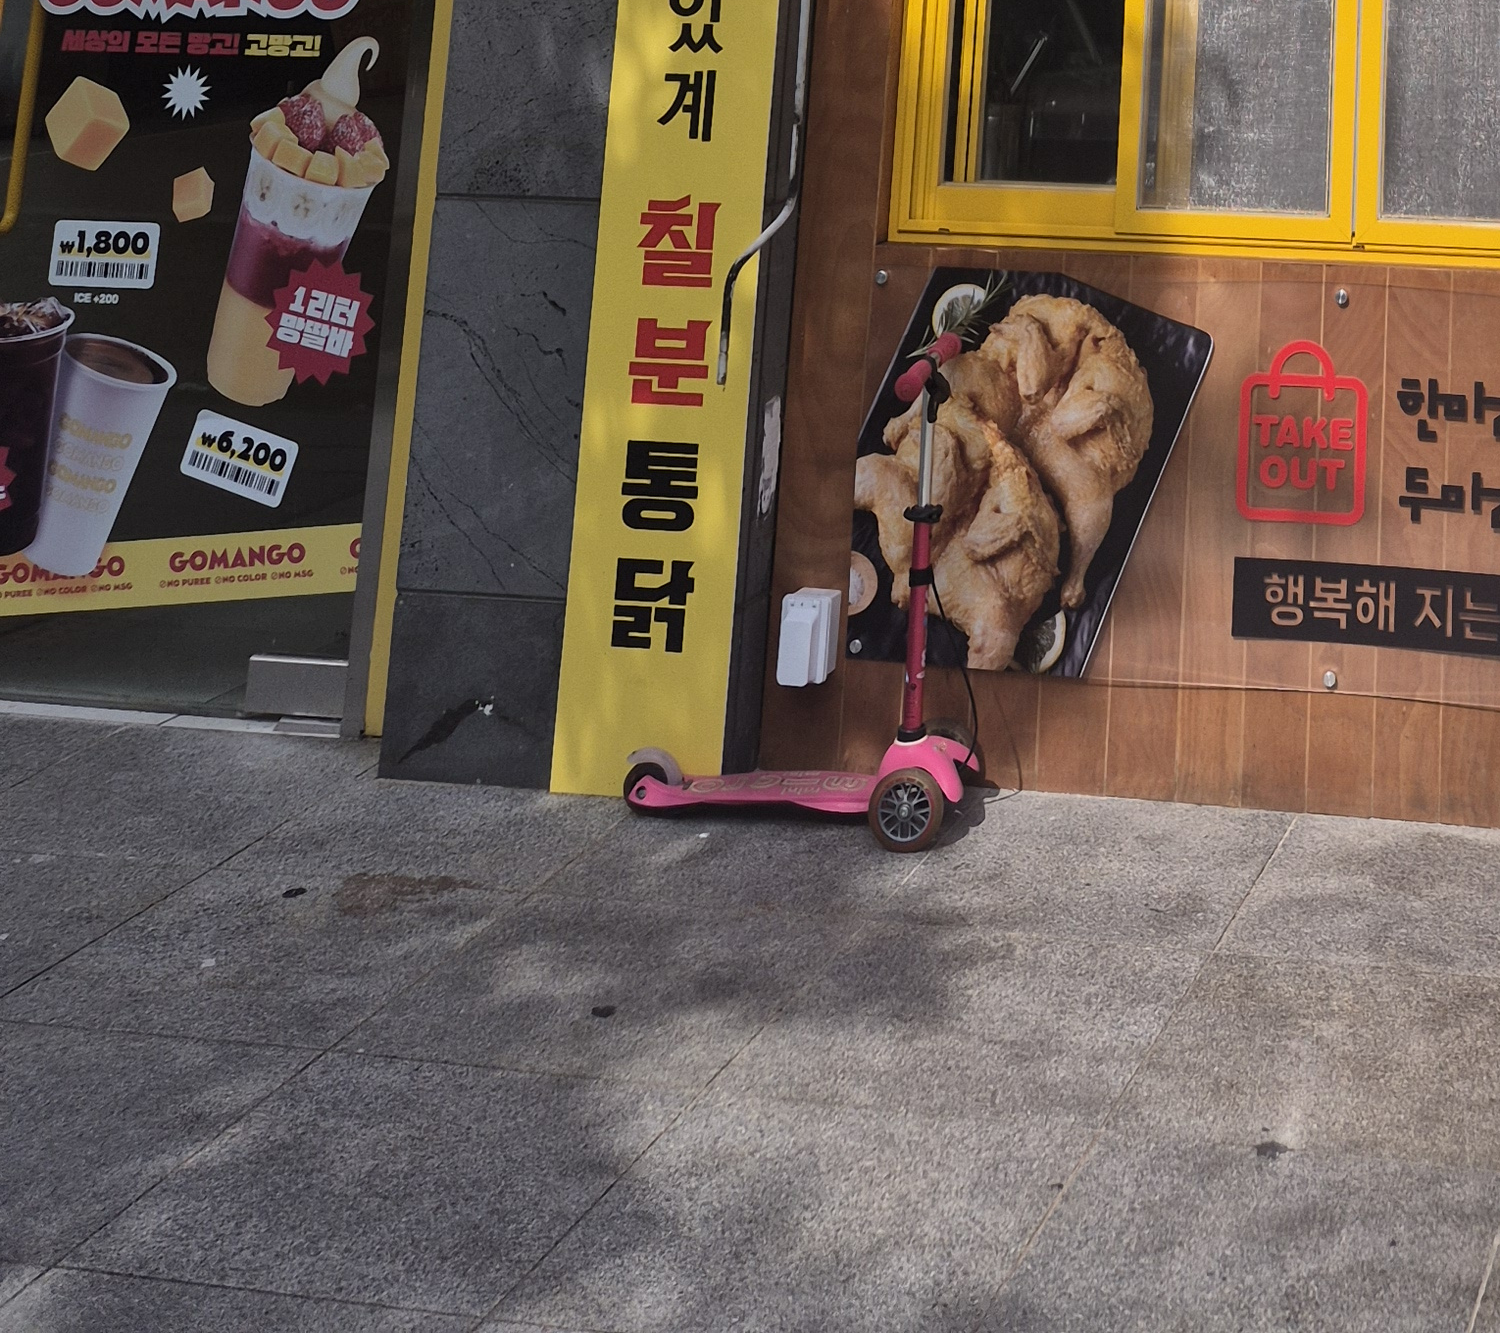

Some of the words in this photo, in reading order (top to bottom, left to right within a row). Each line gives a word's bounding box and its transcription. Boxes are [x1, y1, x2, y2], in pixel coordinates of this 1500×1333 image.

[61, 29, 131, 52] 세상의
[134, 32, 182, 54] 모든
[244, 34, 322, 57] 고망고!
[74, 292, 92, 303] ICE
[628, 194, 721, 407] 칠분
[1253, 414, 1354, 452] TAKE
[1259, 455, 1347, 491] OUT
[169, 542, 306, 573] GOMANGO
[610, 439, 700, 653] 통닭
[181, 576, 211, 586] PUREE
[237, 572, 268, 583] COLOR
[1263, 573, 1397, 633] 행복해
